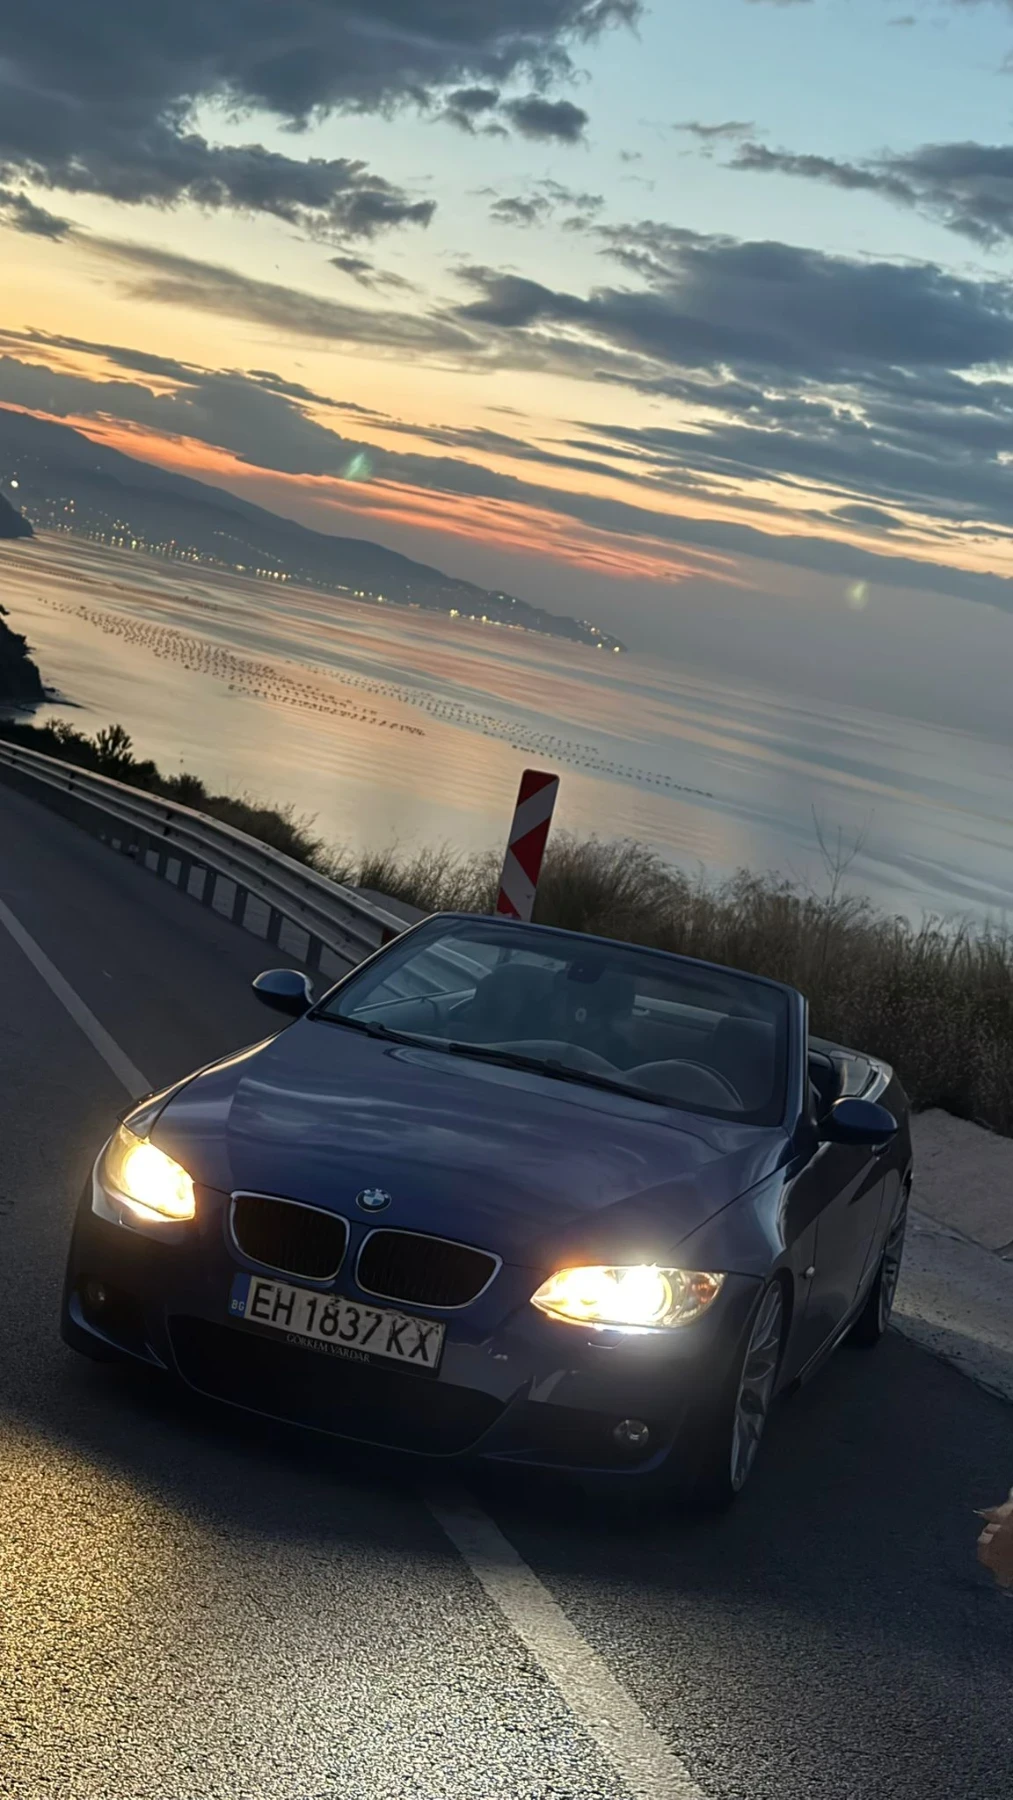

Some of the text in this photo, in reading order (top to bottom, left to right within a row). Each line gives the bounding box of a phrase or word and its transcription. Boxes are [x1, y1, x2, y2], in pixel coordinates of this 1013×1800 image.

[231, 1299, 245, 1312] BG
[250, 1282, 437, 1362] EH 1837 KX
